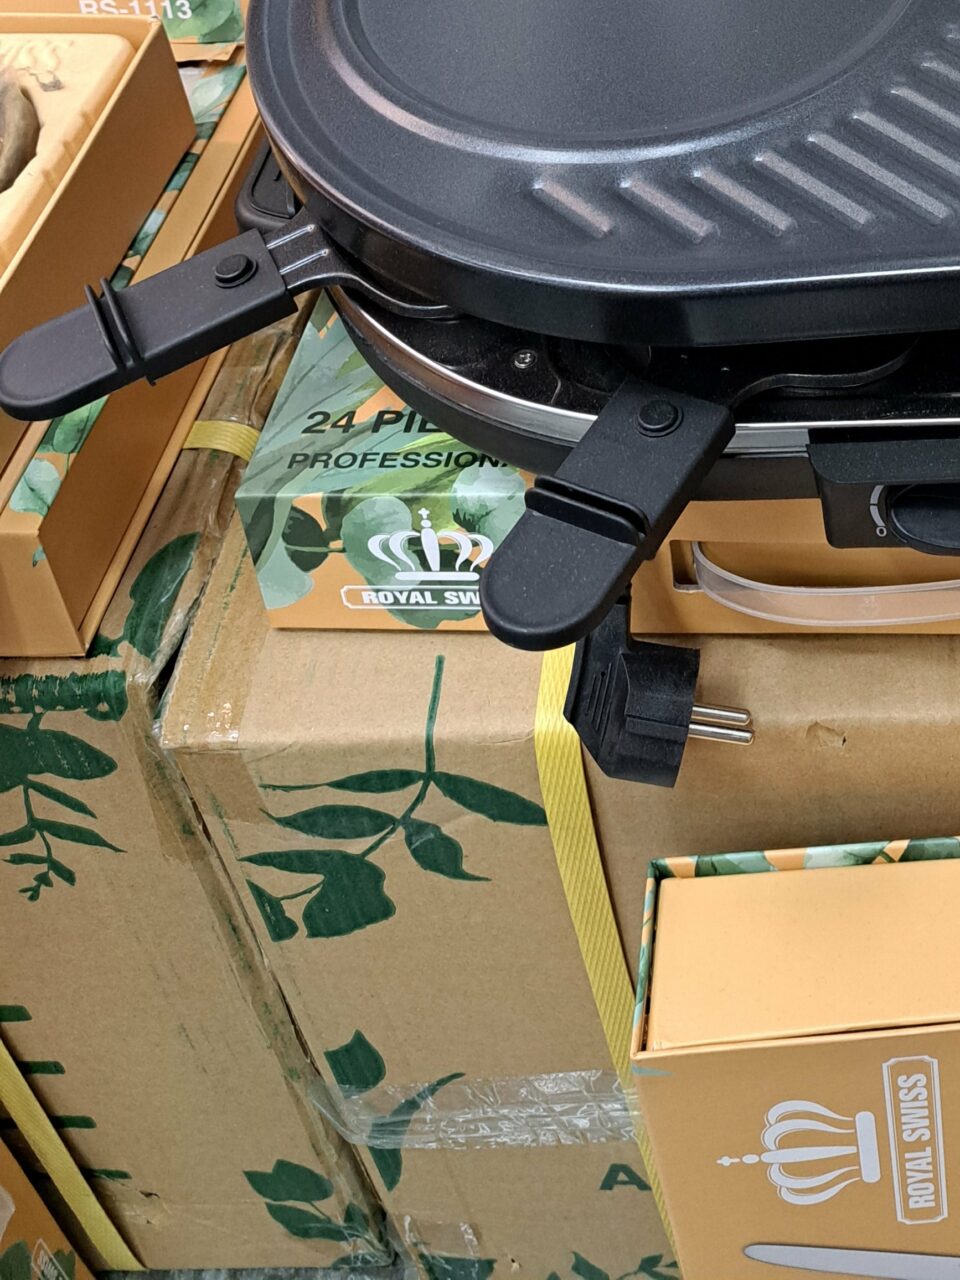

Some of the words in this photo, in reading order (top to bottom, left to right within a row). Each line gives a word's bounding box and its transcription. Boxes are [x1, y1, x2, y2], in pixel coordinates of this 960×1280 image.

[79, 0, 193, 19] RS-1113
[301, 410, 357, 434] 24
[287, 451, 508, 469] PROFESSION
[361, 591, 438, 605] ROYAL
[897, 1073, 931, 1142] SWISS
[904, 1146, 936, 1209] ROYAL
